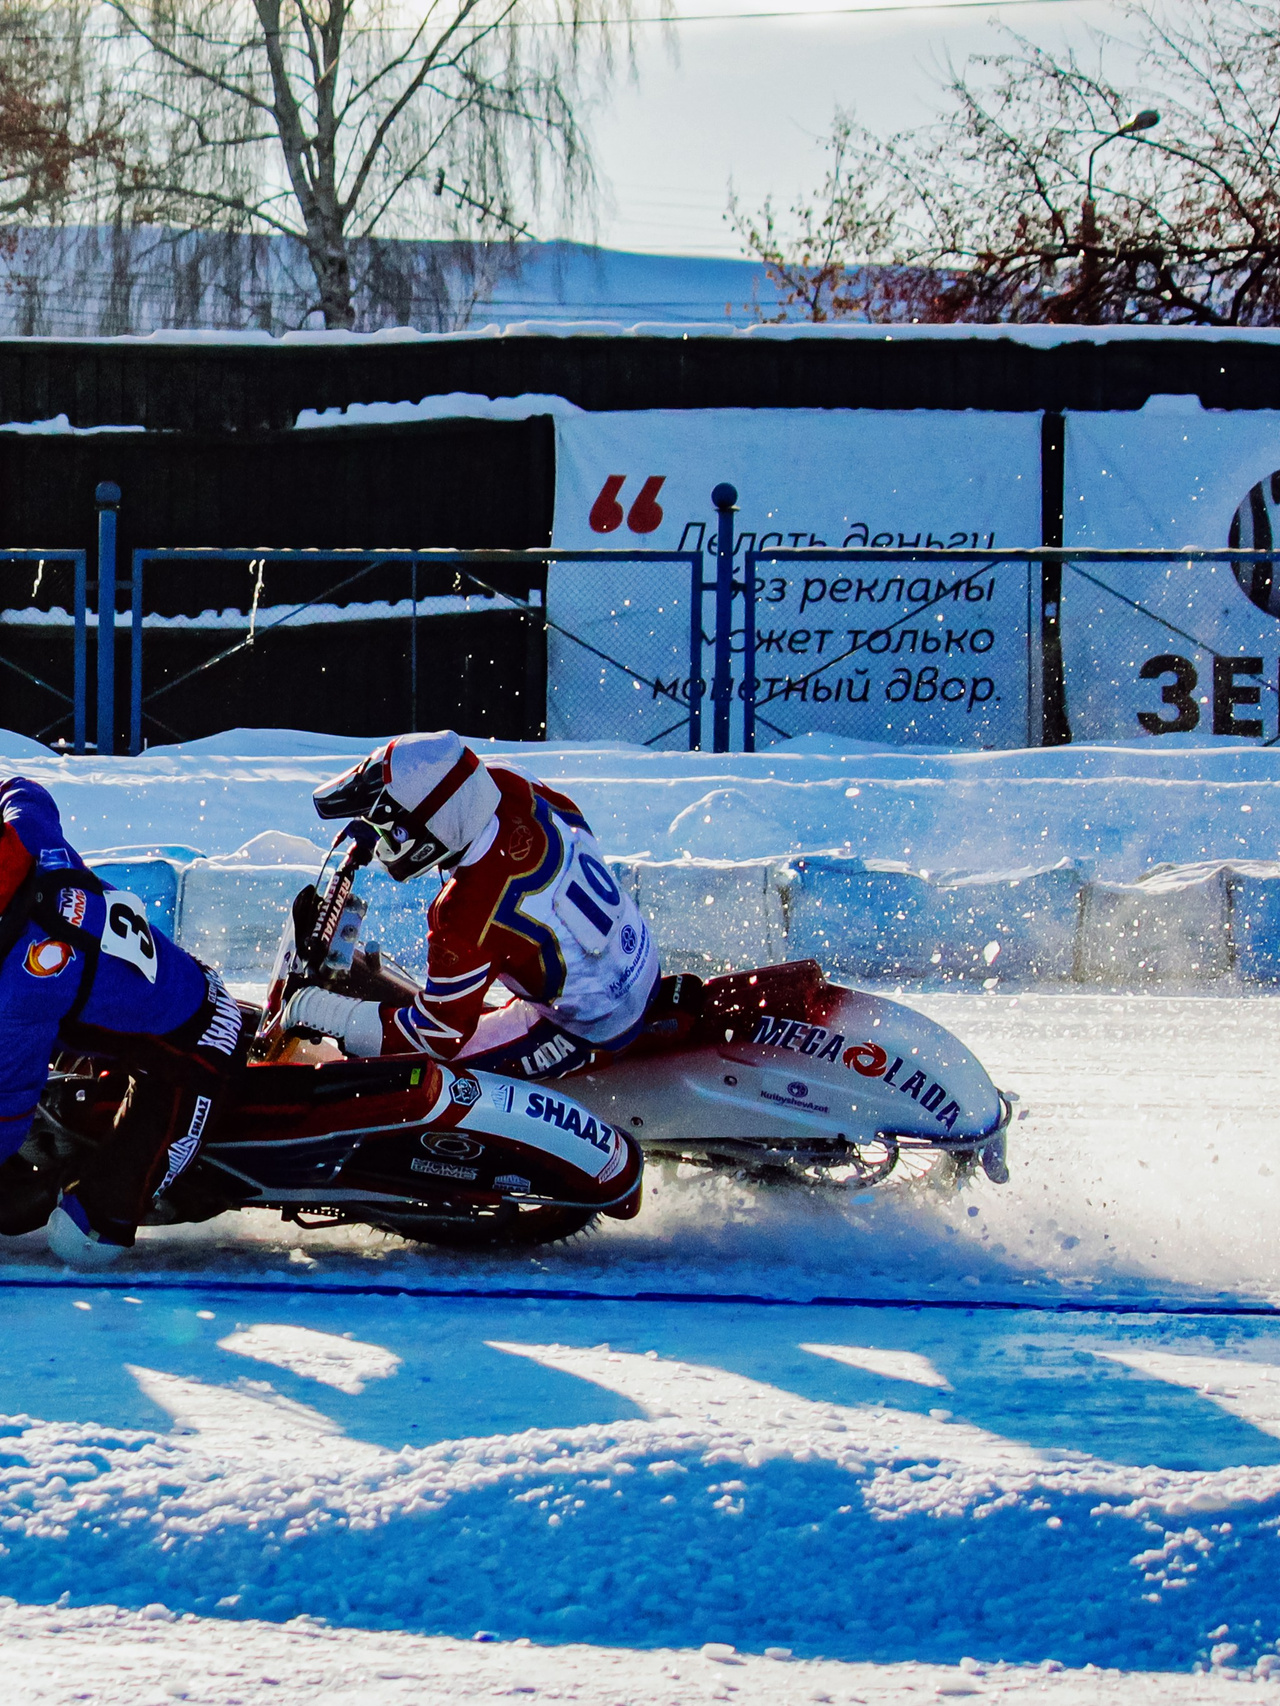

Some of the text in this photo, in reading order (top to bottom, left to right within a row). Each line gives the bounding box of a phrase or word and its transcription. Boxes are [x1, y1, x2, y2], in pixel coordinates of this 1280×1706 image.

[799, 577, 996, 614] рекламы
[847, 627, 996, 654] только
[885, 666, 1002, 714] двор.
[320, 876, 352, 942] RENTHAL
[565, 852, 620, 937] 10
[109, 902, 154, 960] 3
[521, 1033, 577, 1076] LADA
[752, 1015, 961, 1133] MEGA LADA
[190, 1097, 209, 1137] SHAAZ
[525, 1092, 613, 1154] SHAAZ
